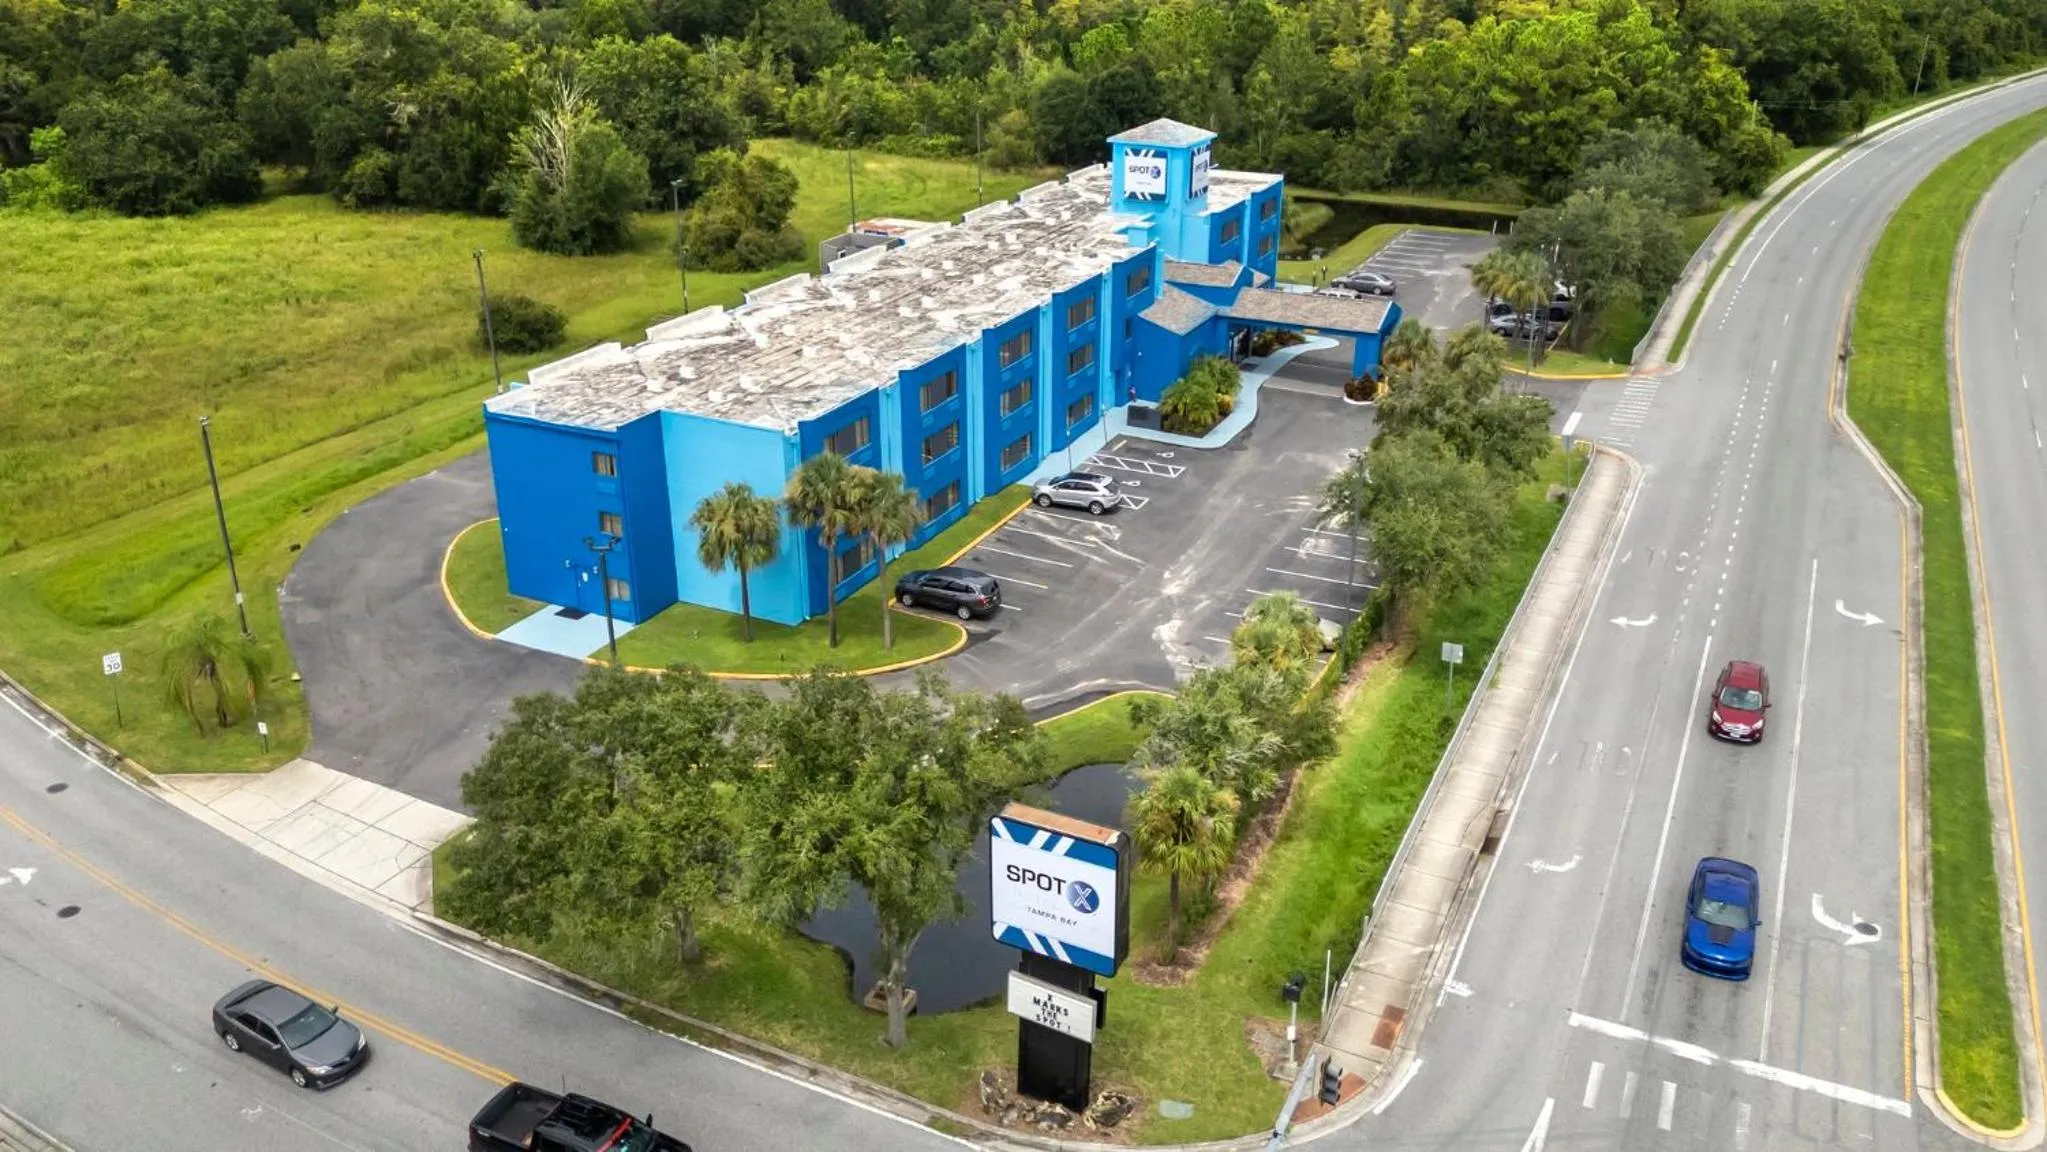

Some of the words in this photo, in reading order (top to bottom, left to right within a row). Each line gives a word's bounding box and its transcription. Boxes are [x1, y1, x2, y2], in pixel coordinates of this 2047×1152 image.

[1129, 165, 1149, 173] SPOT
[1006, 864, 1066, 895] SPOT
[1072, 881, 1094, 912] X
[1026, 906, 1057, 920] TAMPA
[1060, 916, 1078, 926] BAY
[1033, 995, 1069, 1017] MARKS
[1041, 1007, 1057, 1020] THE
[1036, 1013, 1061, 1029] SPOT
